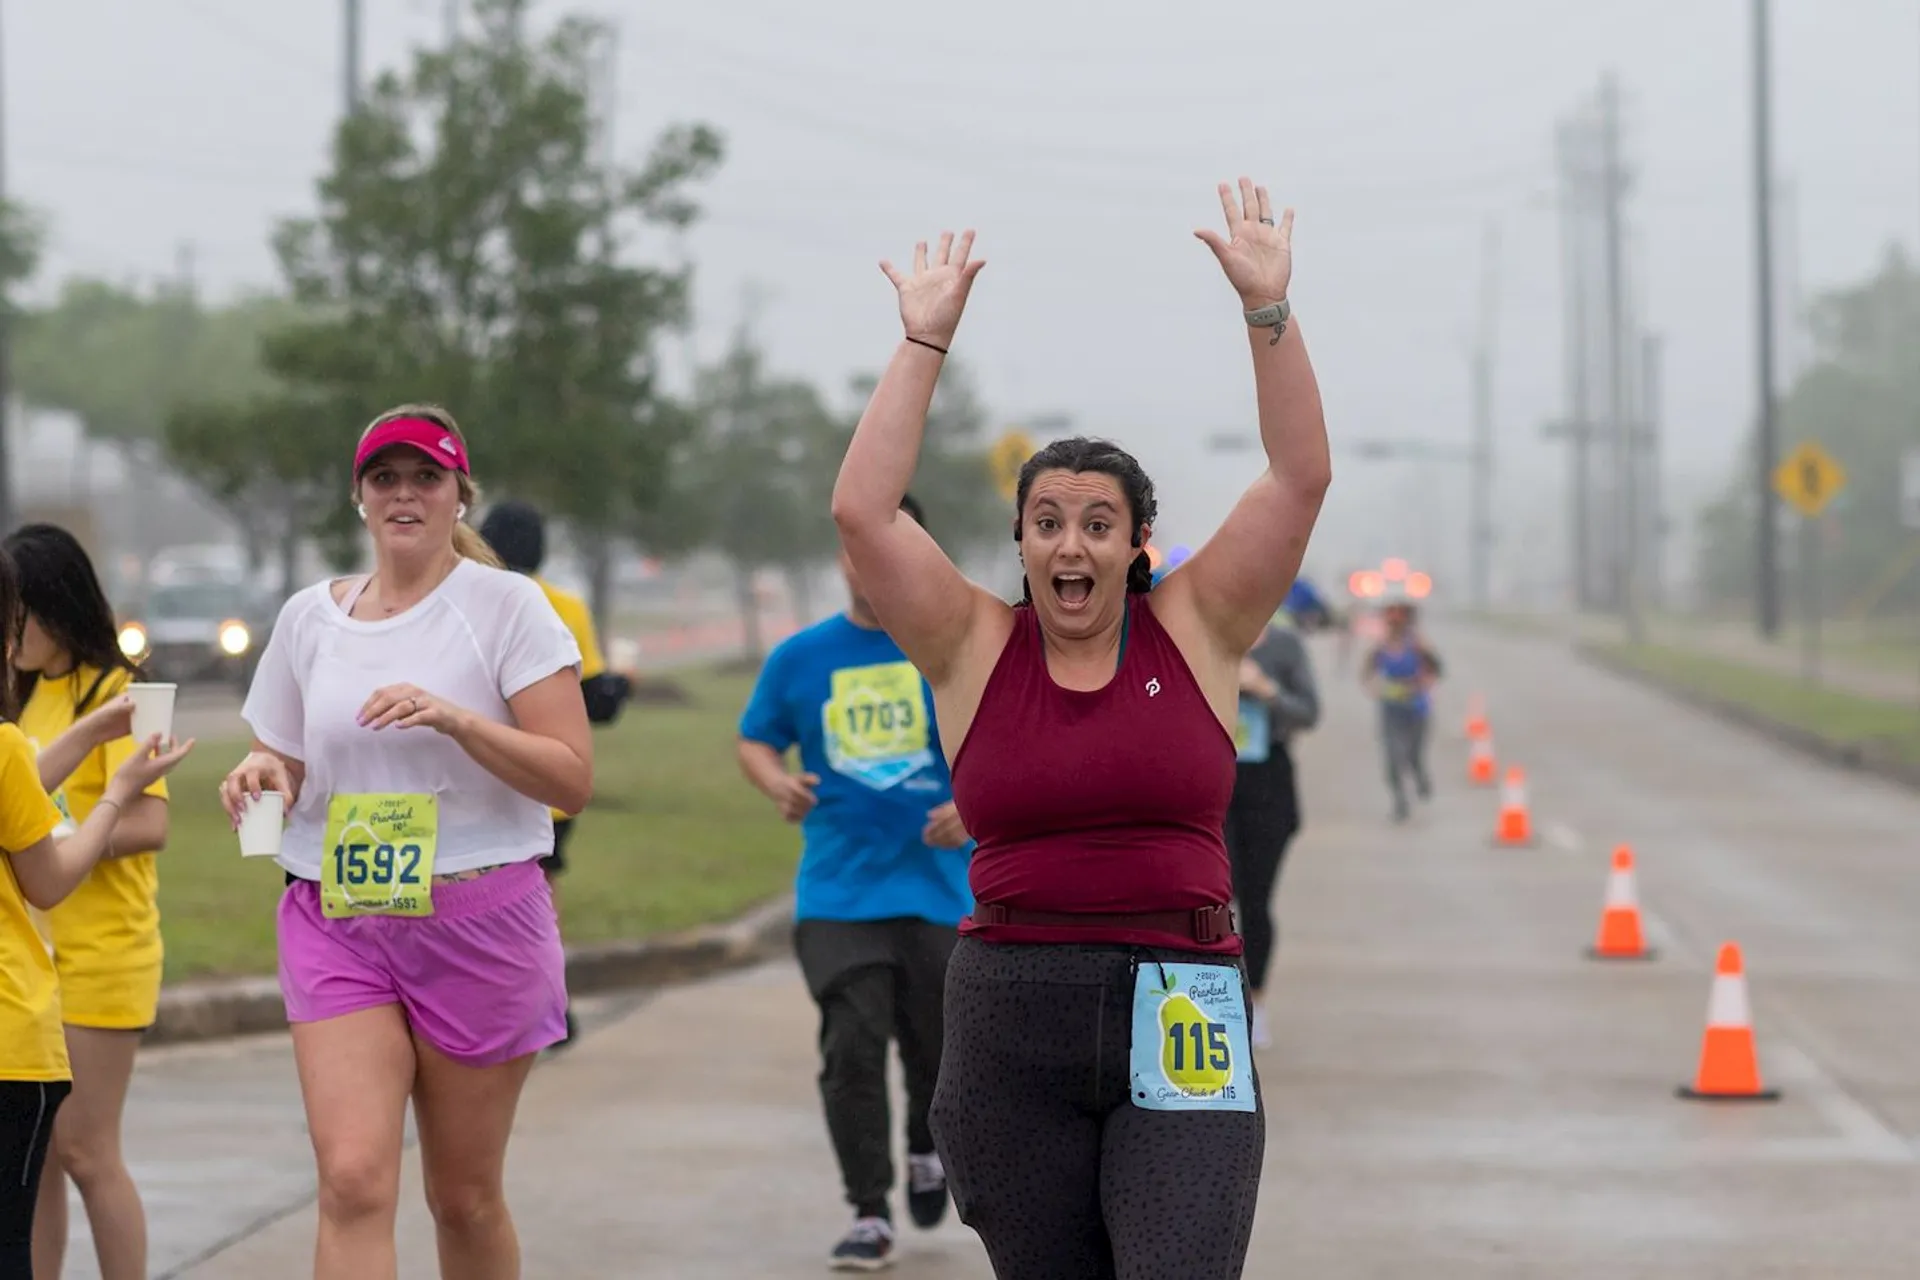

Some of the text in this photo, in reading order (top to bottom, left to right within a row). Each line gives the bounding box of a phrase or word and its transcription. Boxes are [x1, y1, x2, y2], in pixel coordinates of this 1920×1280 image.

[846, 698, 914, 734] 1703
[333, 844, 422, 885] 1592
[393, 896, 417, 909] 1592
[1189, 980, 1228, 1000] Pearland
[1169, 1022, 1231, 1071] 115
[1221, 1085, 1236, 1099] 115
